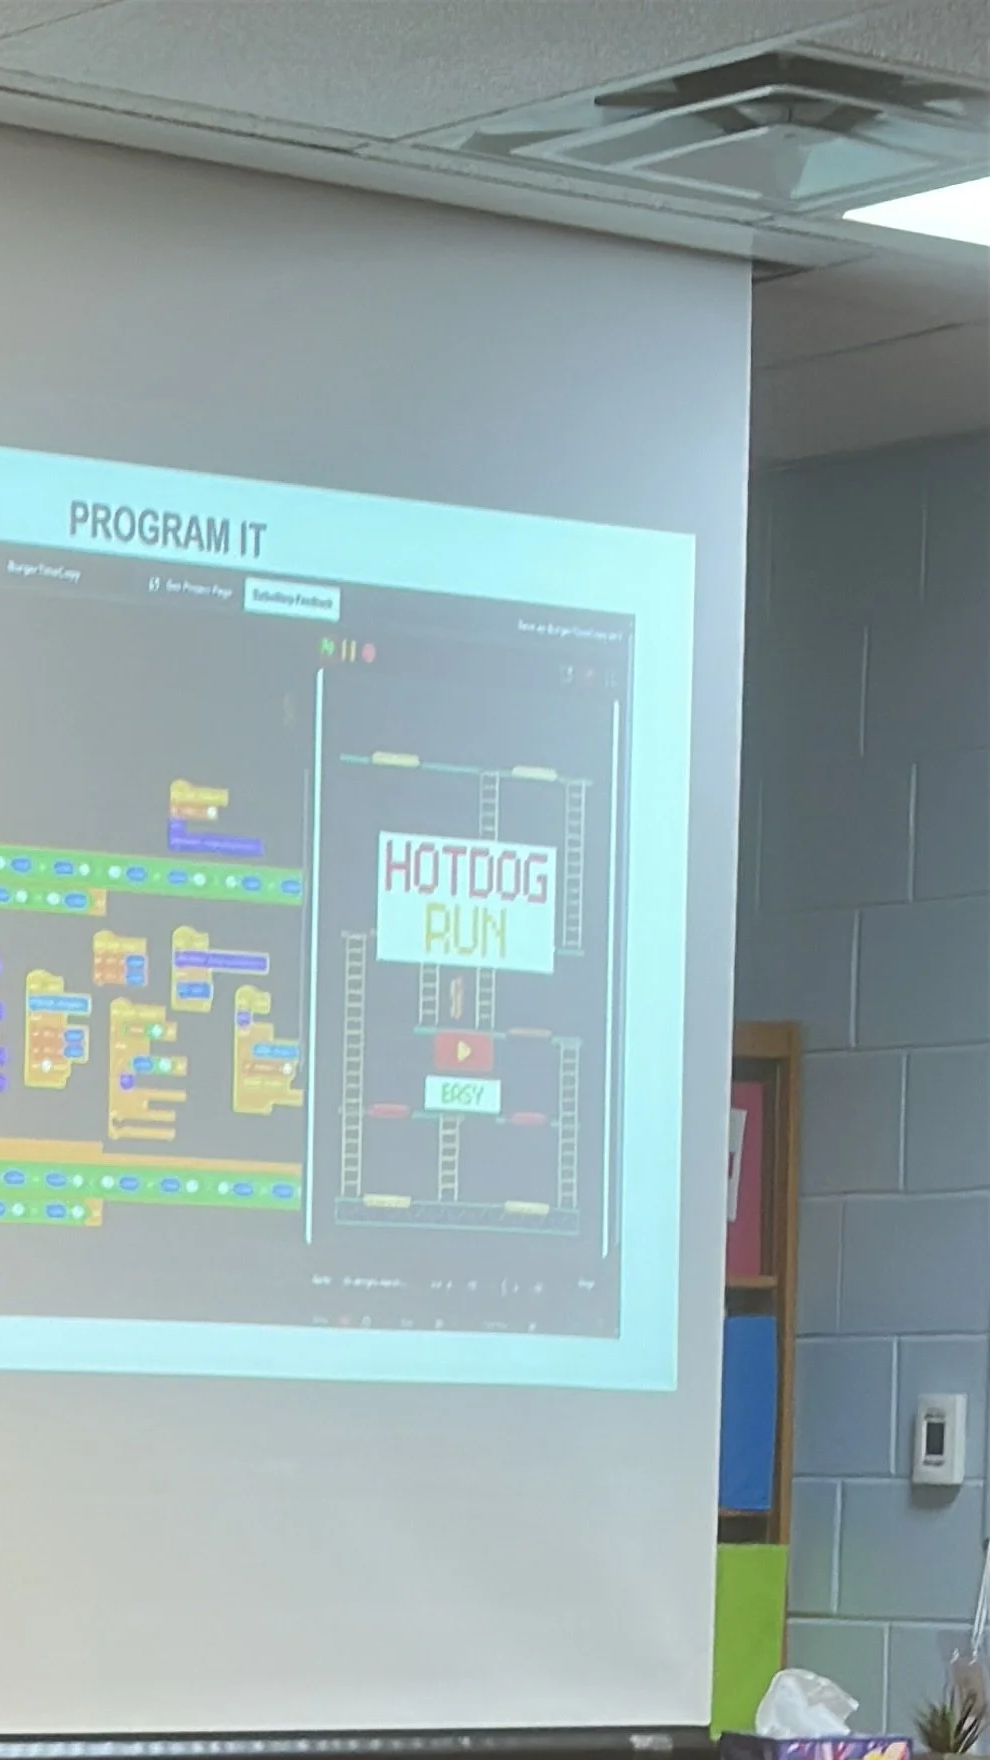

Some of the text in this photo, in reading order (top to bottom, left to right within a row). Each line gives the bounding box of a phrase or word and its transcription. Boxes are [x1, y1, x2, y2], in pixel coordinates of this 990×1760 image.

[70, 500, 267, 558] PROGRAM IT
[385, 839, 548, 904] HOTDOG
[425, 902, 508, 959] RUN
[441, 1081, 484, 1106] EASY
